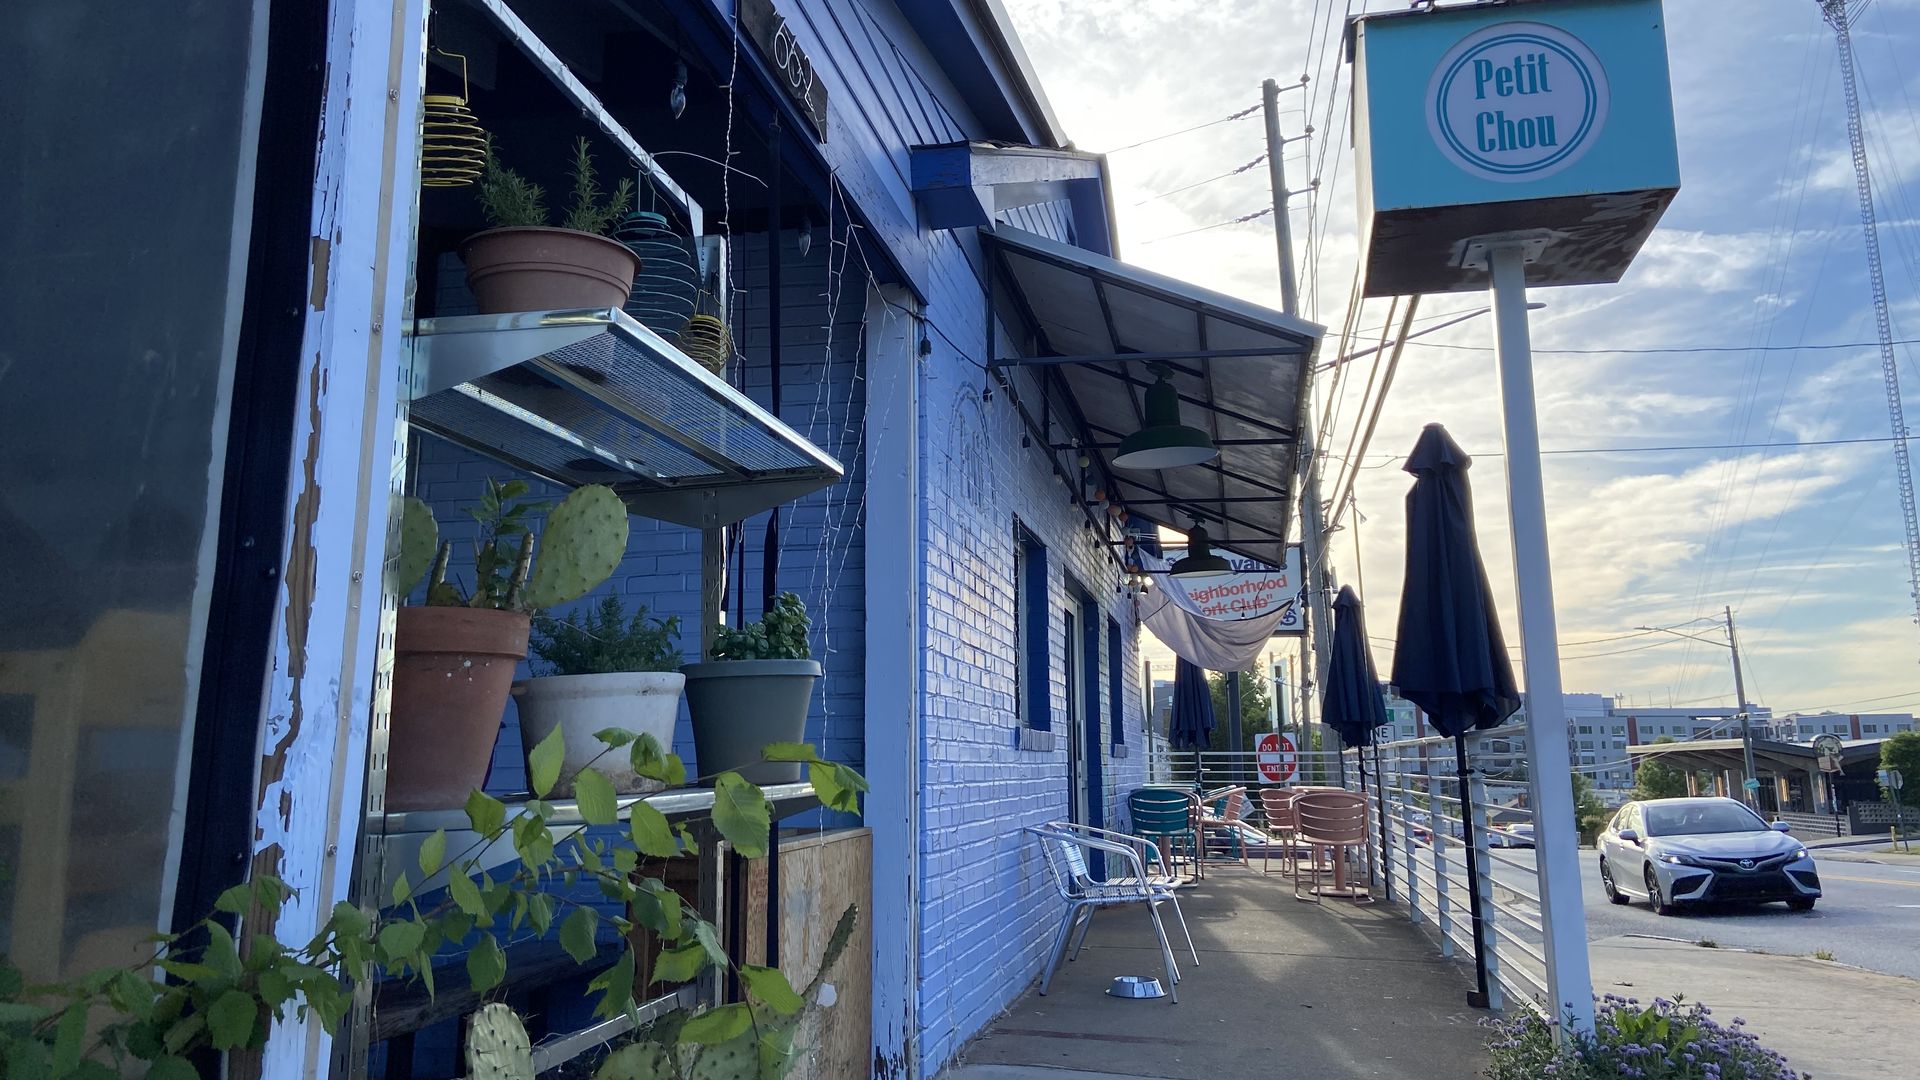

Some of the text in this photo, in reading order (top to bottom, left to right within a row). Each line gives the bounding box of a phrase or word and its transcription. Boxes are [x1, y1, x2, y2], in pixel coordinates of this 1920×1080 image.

[1473, 53, 1552, 100] Petit
[1475, 110, 1557, 153] Chou
[1188, 574, 1288, 603] eighborhood
[1199, 601, 1228, 617] ork
[1262, 743, 1273, 752] DO
